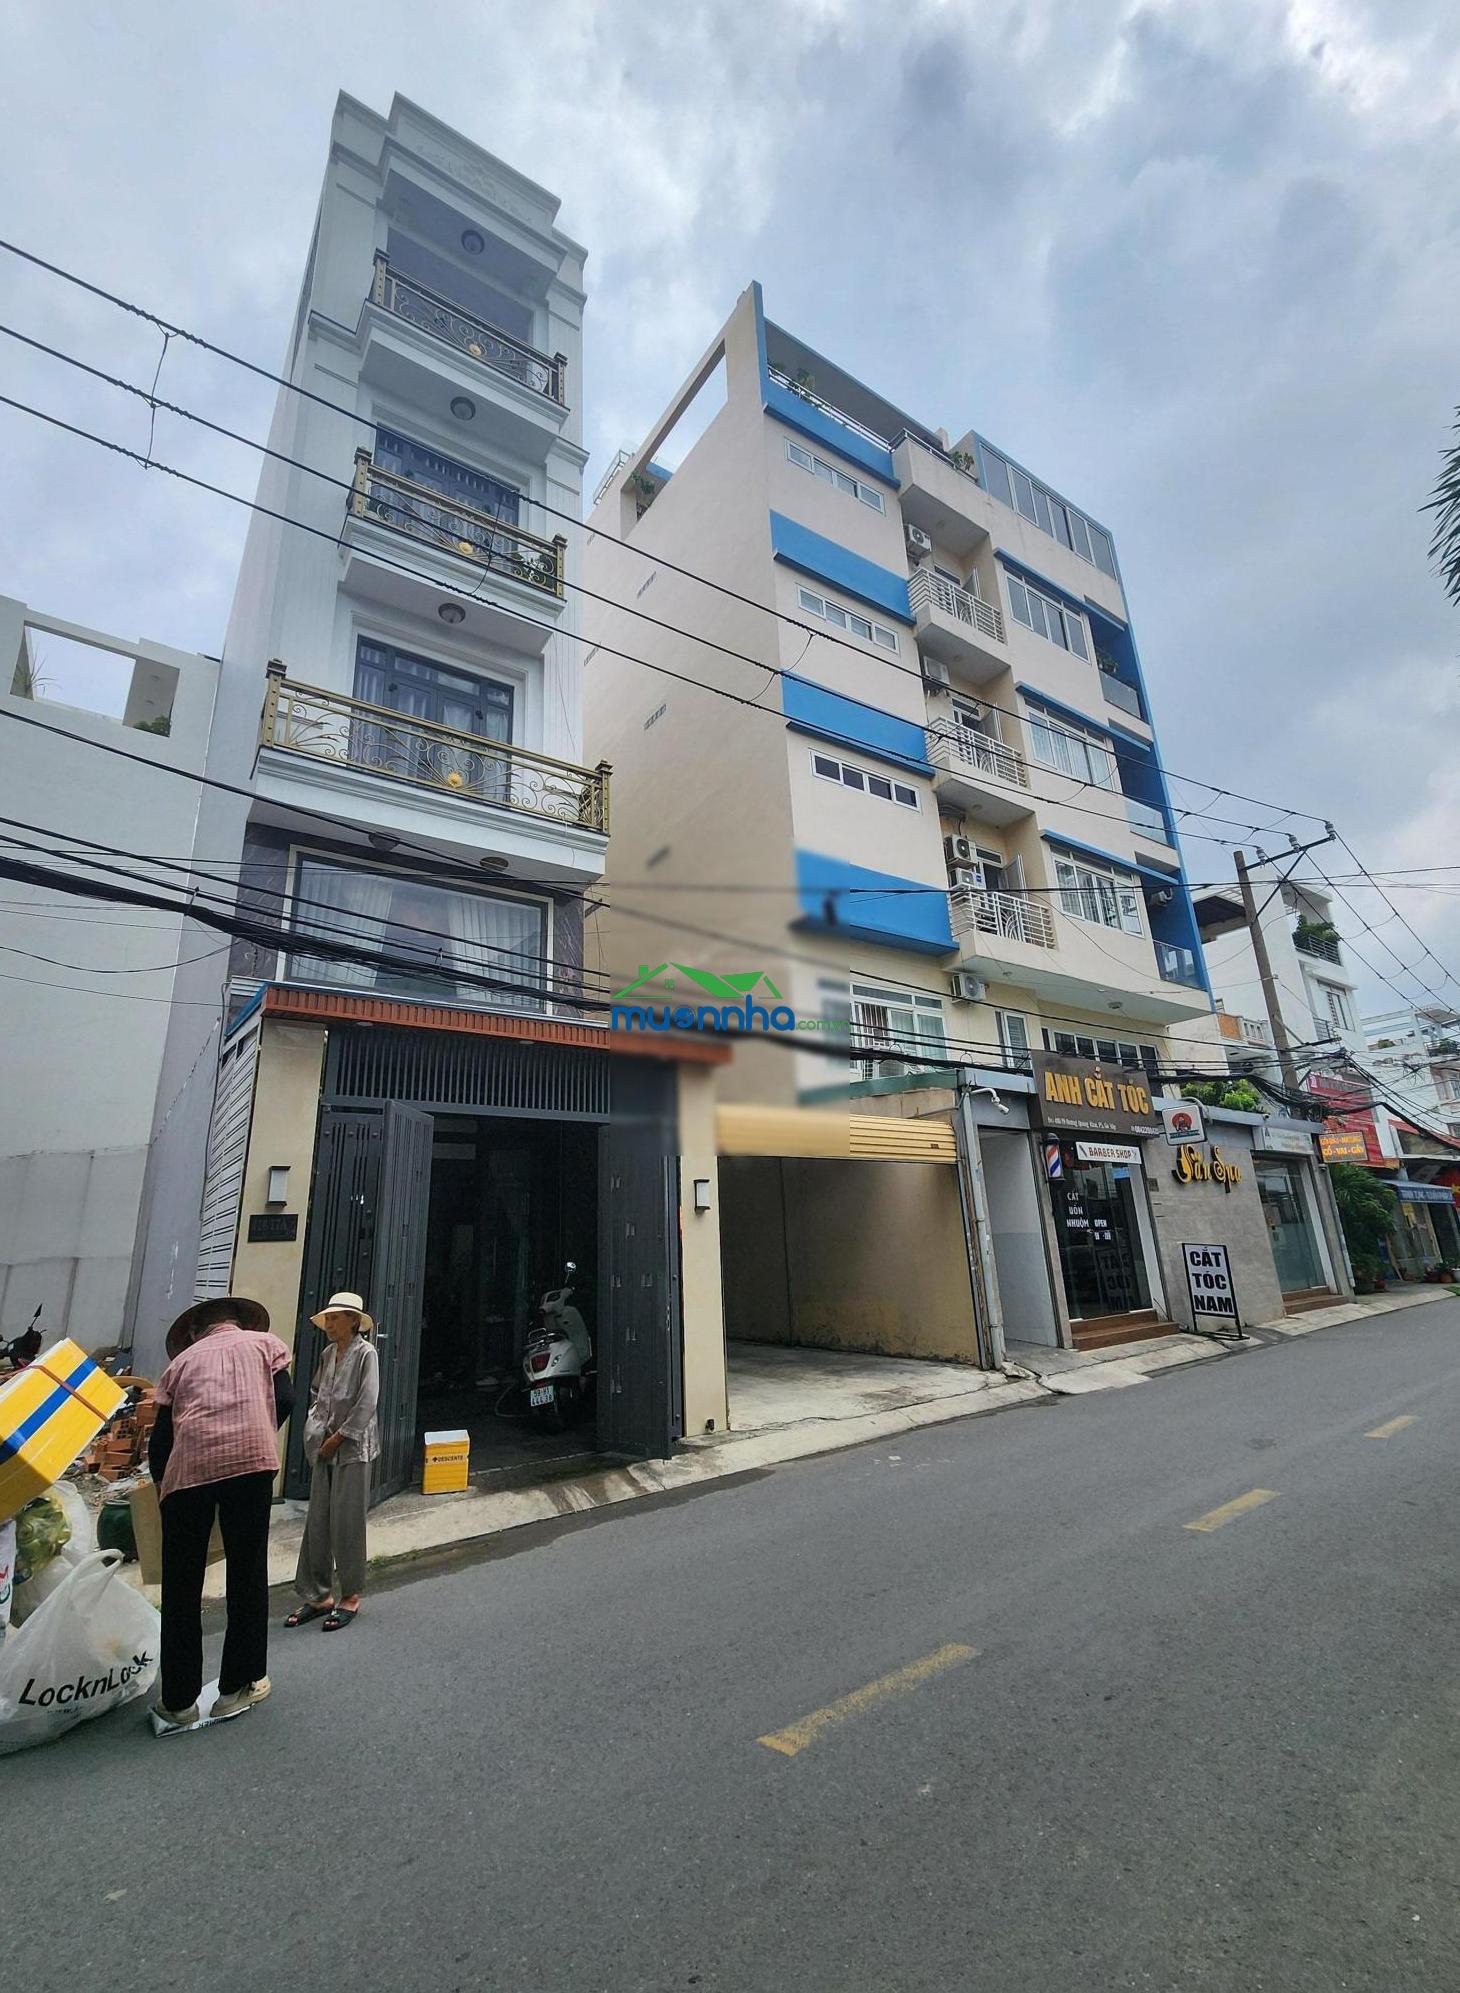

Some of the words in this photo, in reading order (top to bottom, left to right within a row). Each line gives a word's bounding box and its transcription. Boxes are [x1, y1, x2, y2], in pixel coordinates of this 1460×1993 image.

[1044, 1071, 1083, 1106] ANH
[1085, 1066, 1116, 1110] CẮT
[1117, 1079, 1149, 1115] TÓC
[1088, 1147, 1117, 1159] BARBER
[1117, 1150, 1132, 1160] SHOP
[1211, 1145, 1243, 1193] Spa
[1189, 1246, 1222, 1268] CẮT
[1192, 1270, 1227, 1291] TÓC
[1194, 1294, 1234, 1314] NAM
[18, 1651, 154, 1707] LocknLock
